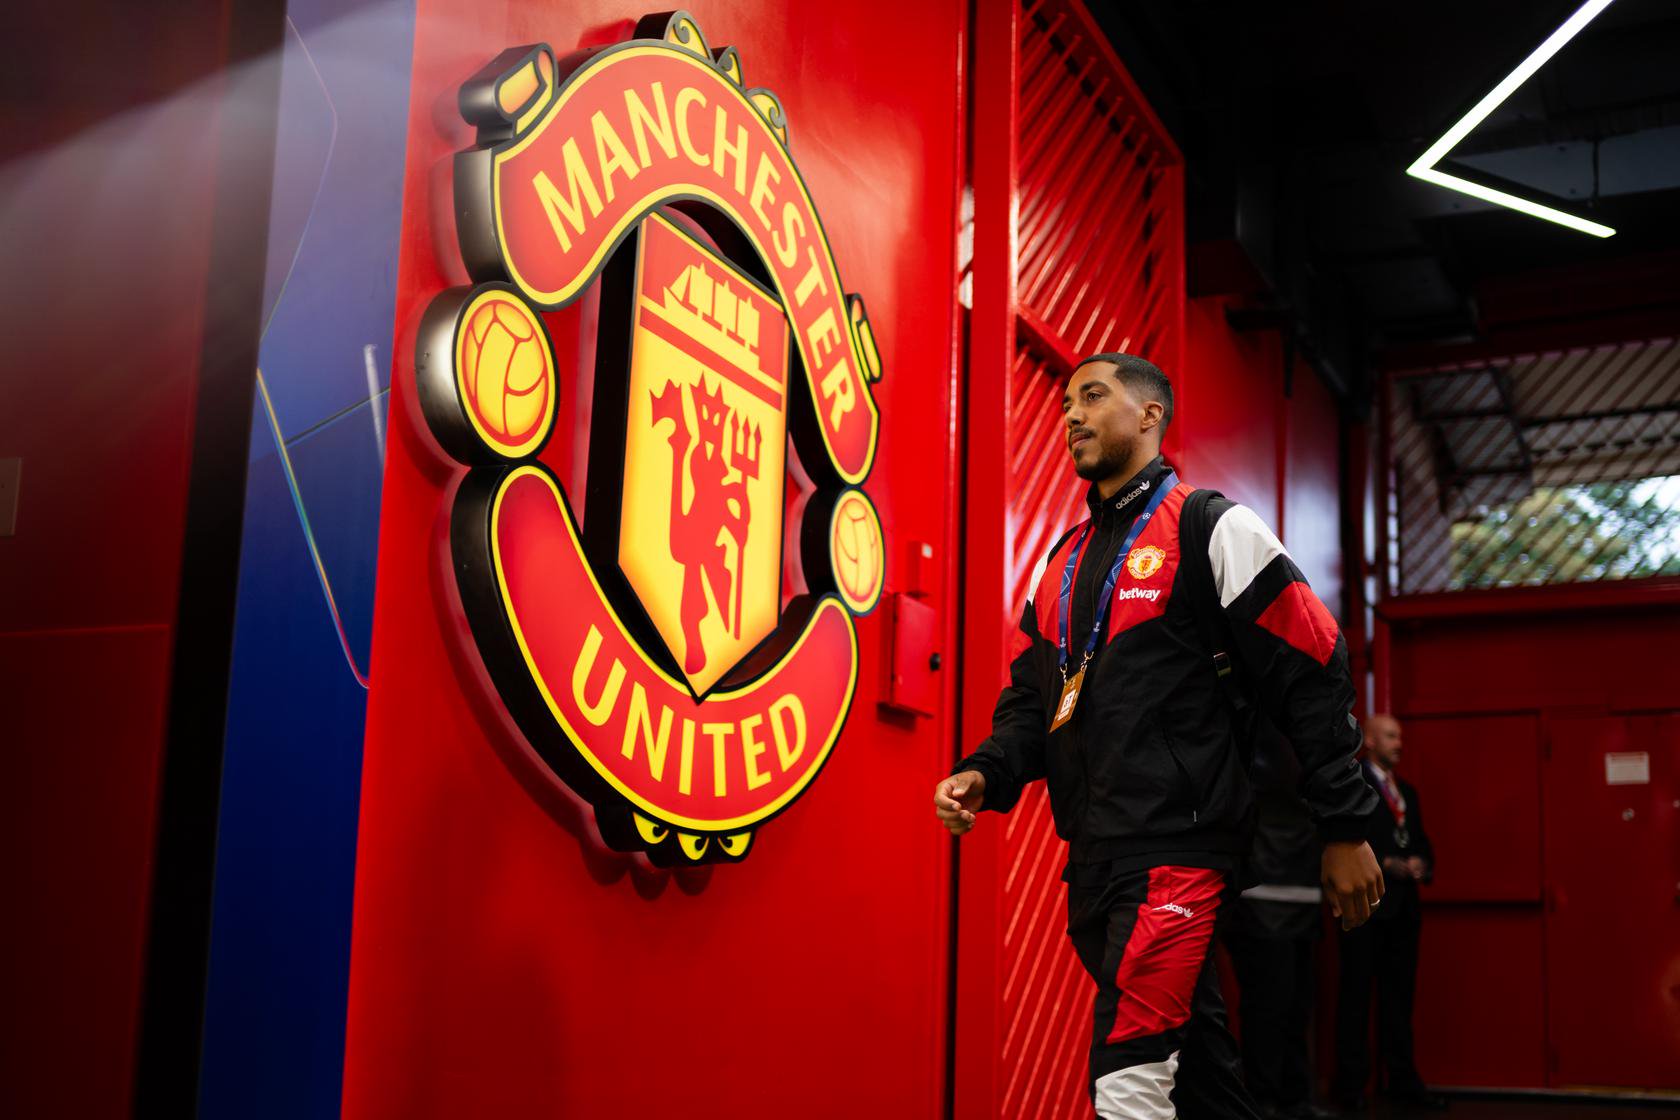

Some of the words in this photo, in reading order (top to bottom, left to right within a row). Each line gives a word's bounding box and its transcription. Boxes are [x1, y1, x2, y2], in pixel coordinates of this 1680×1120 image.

[532, 82, 855, 432] MANCHESTER
[1115, 488, 1142, 510] adidas
[1119, 588, 1161, 602] betway
[572, 623, 807, 797] UNITED
